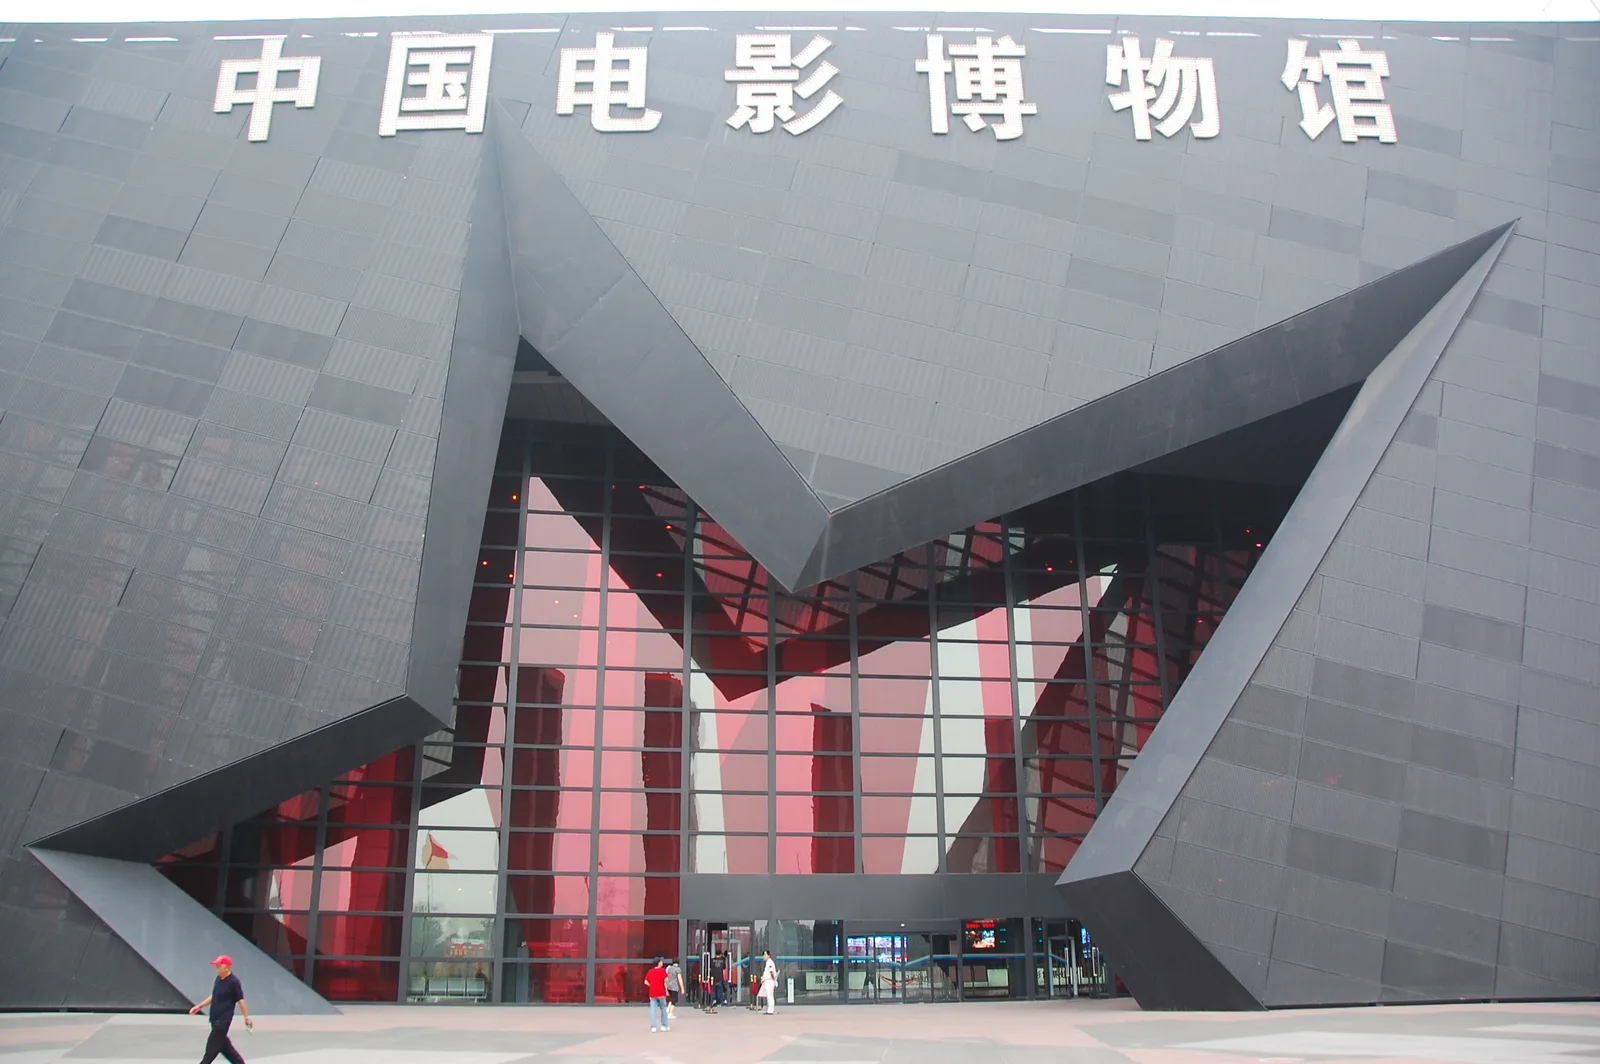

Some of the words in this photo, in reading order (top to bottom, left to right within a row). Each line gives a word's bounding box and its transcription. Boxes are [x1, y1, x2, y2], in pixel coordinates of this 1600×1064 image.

[214, 32, 1397, 143] 中国电影博物馆
